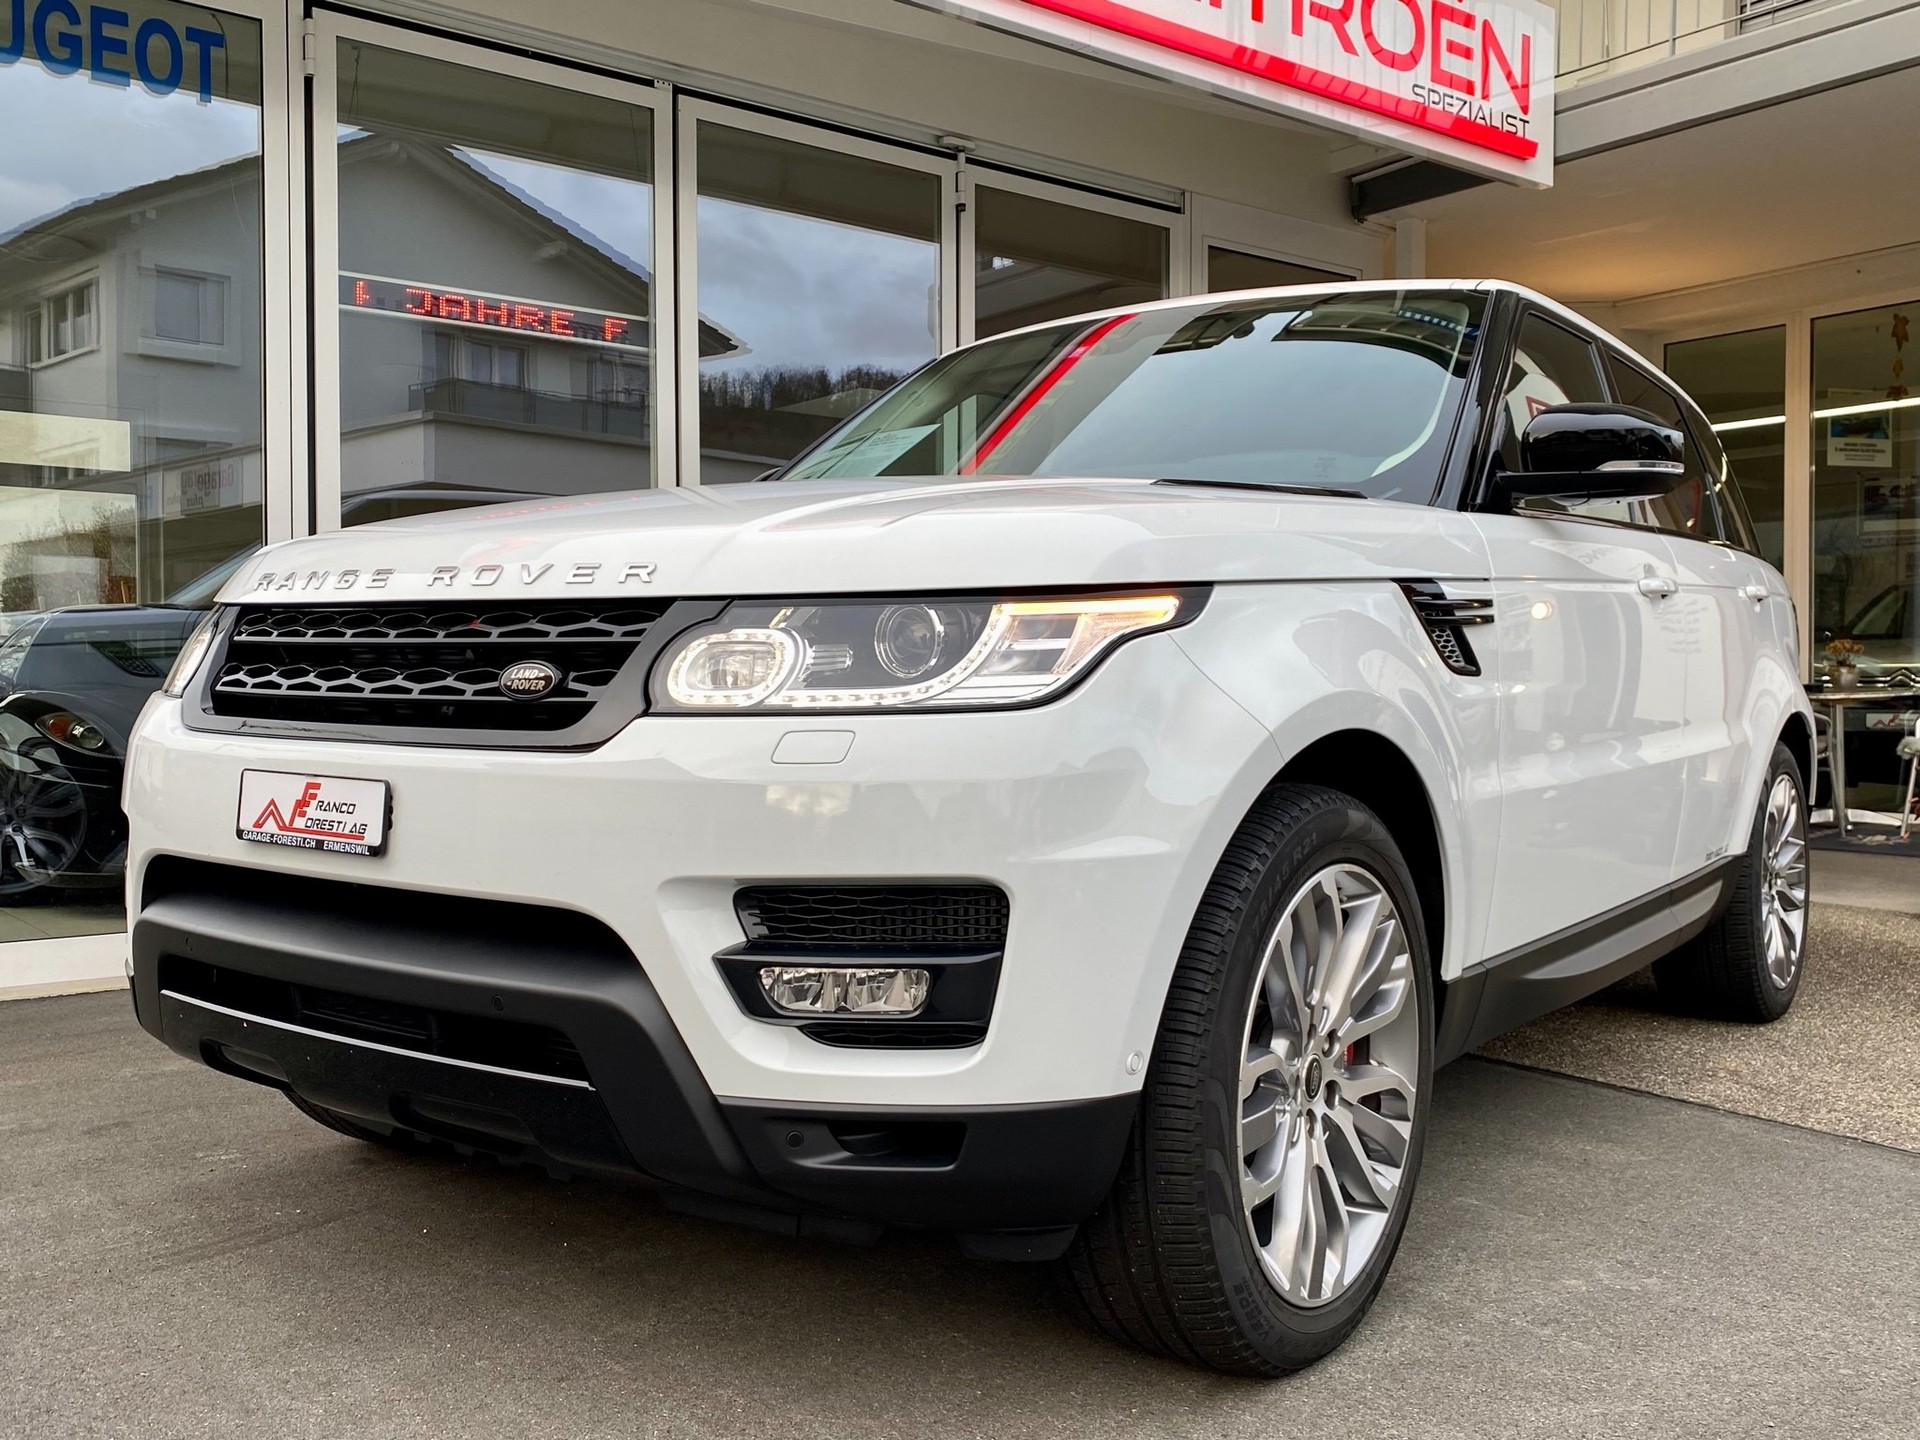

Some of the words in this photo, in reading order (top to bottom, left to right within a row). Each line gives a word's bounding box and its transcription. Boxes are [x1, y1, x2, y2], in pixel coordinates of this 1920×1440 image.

[1412, 83, 1530, 139] SPEZIALIST
[406, 287, 574, 336] JAHRE
[253, 567, 396, 591] RANGE
[426, 562, 658, 588] ROVER
[510, 669, 539, 679] LAND
[511, 679, 546, 690] ROVER
[242, 830, 316, 849] GARAGE-FORESTI.CH
[323, 840, 370, 856] ERMENSWIL
